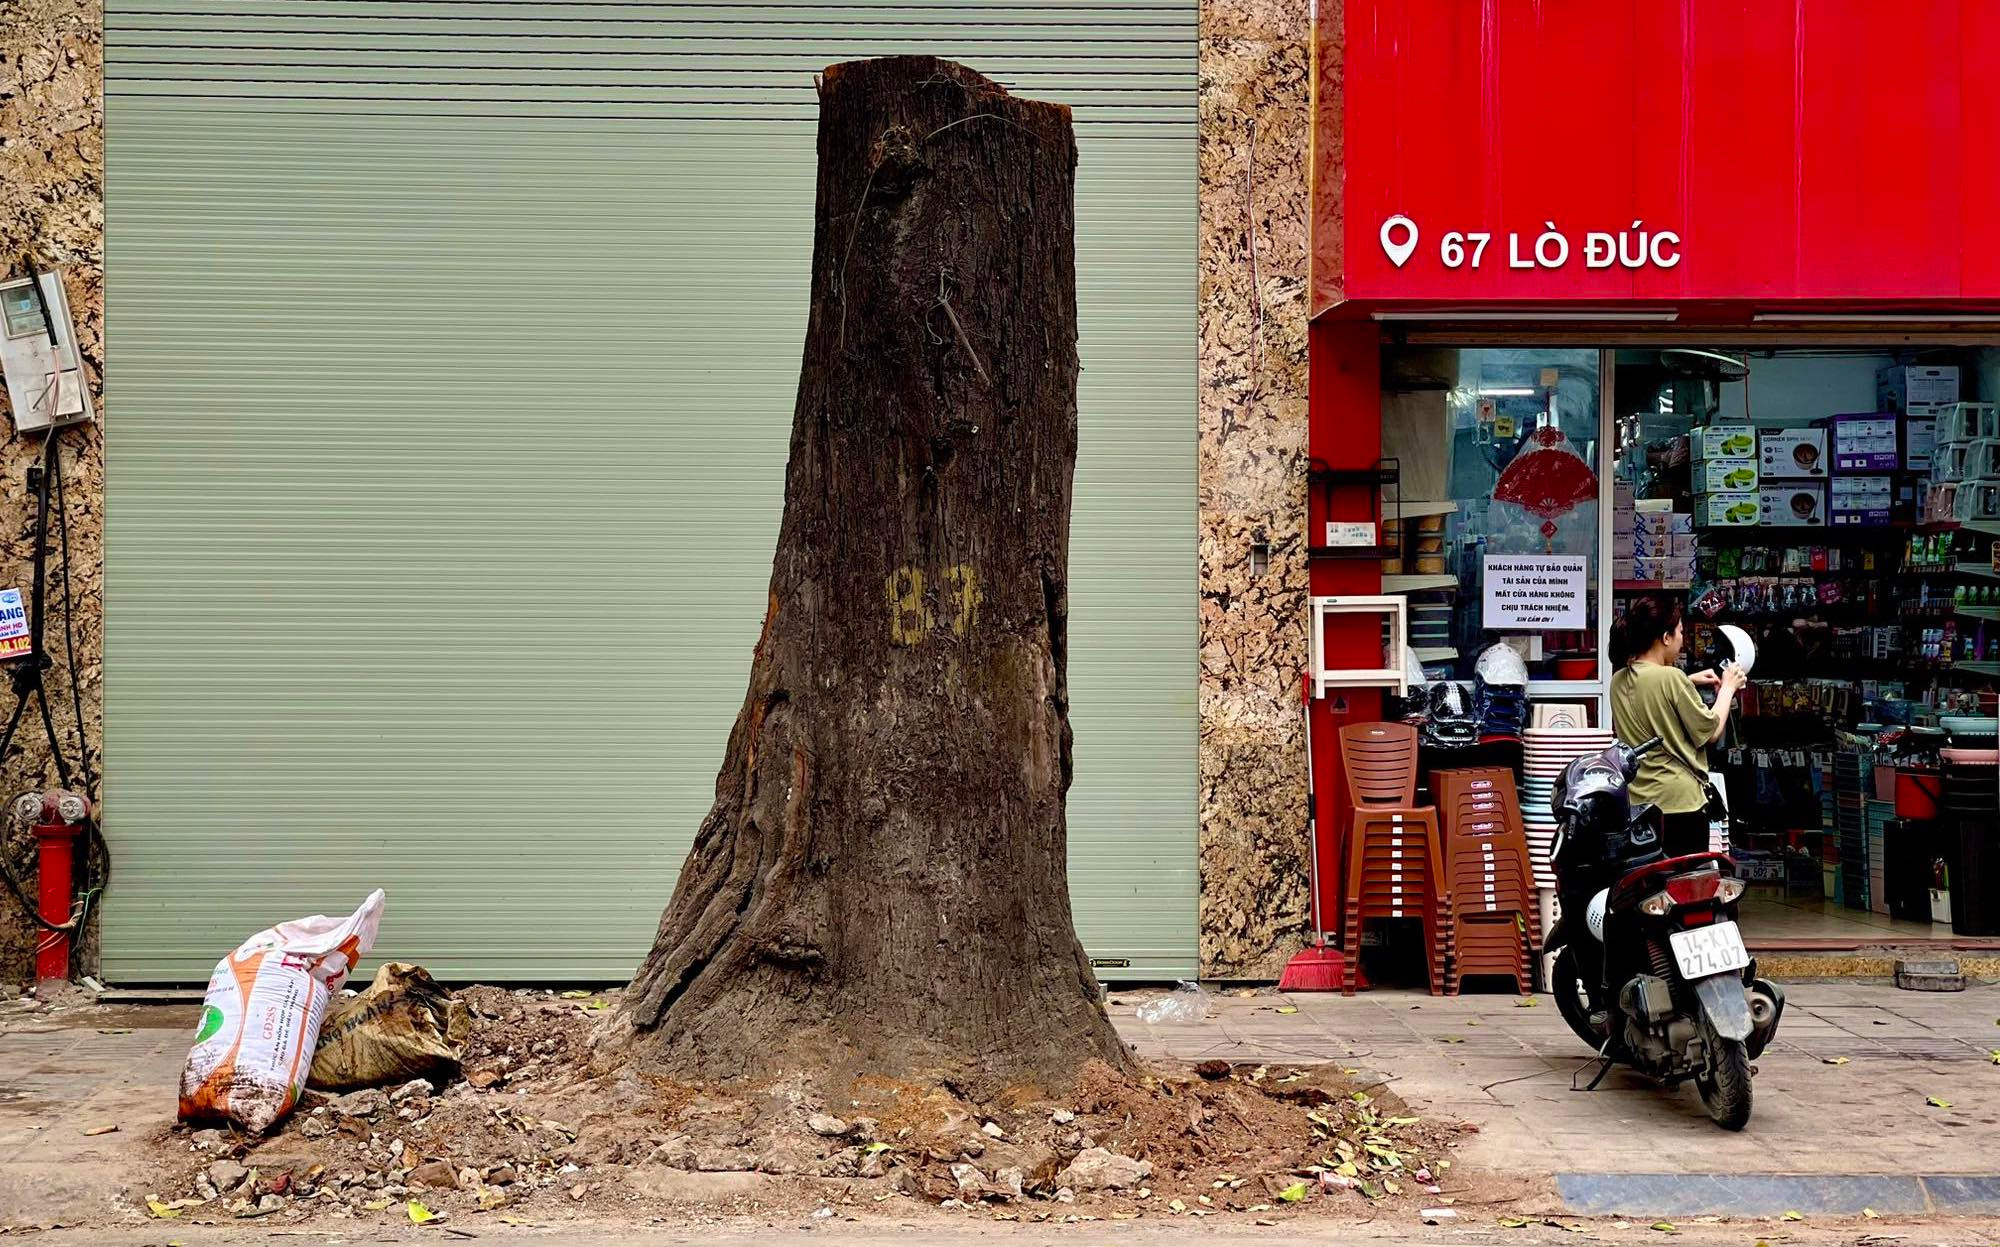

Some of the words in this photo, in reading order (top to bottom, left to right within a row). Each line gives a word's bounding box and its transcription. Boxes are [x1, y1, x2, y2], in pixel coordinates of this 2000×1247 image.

[1441, 232, 1491, 268] 67
[1509, 221, 1569, 268] LÒ
[1584, 220, 1681, 268] ĐÚC
[1488, 563, 1512, 571] KHÁCH
[1514, 563, 1534, 571] HÀNG
[1536, 564, 1545, 573] TỰ
[1546, 562, 1561, 572] BẢO
[1563, 563, 1583, 572] QUẢN
[1502, 577, 1514, 585] TÀI
[1516, 576, 1531, 585] SẢN
[1532, 576, 1547, 585] CỦA
[1549, 577, 1568, 585] MÌNH
[1495, 590, 1511, 598] MẤT
[1512, 589, 1527, 598] CỬA
[1529, 590, 1548, 598] HÀNG
[1550, 590, 1575, 599] KHÔNG
[1501, 604, 1518, 612] CHỊU
[1520, 604, 1543, 612] TRÁCH
[1683, 945, 1741, 976] 274.07
